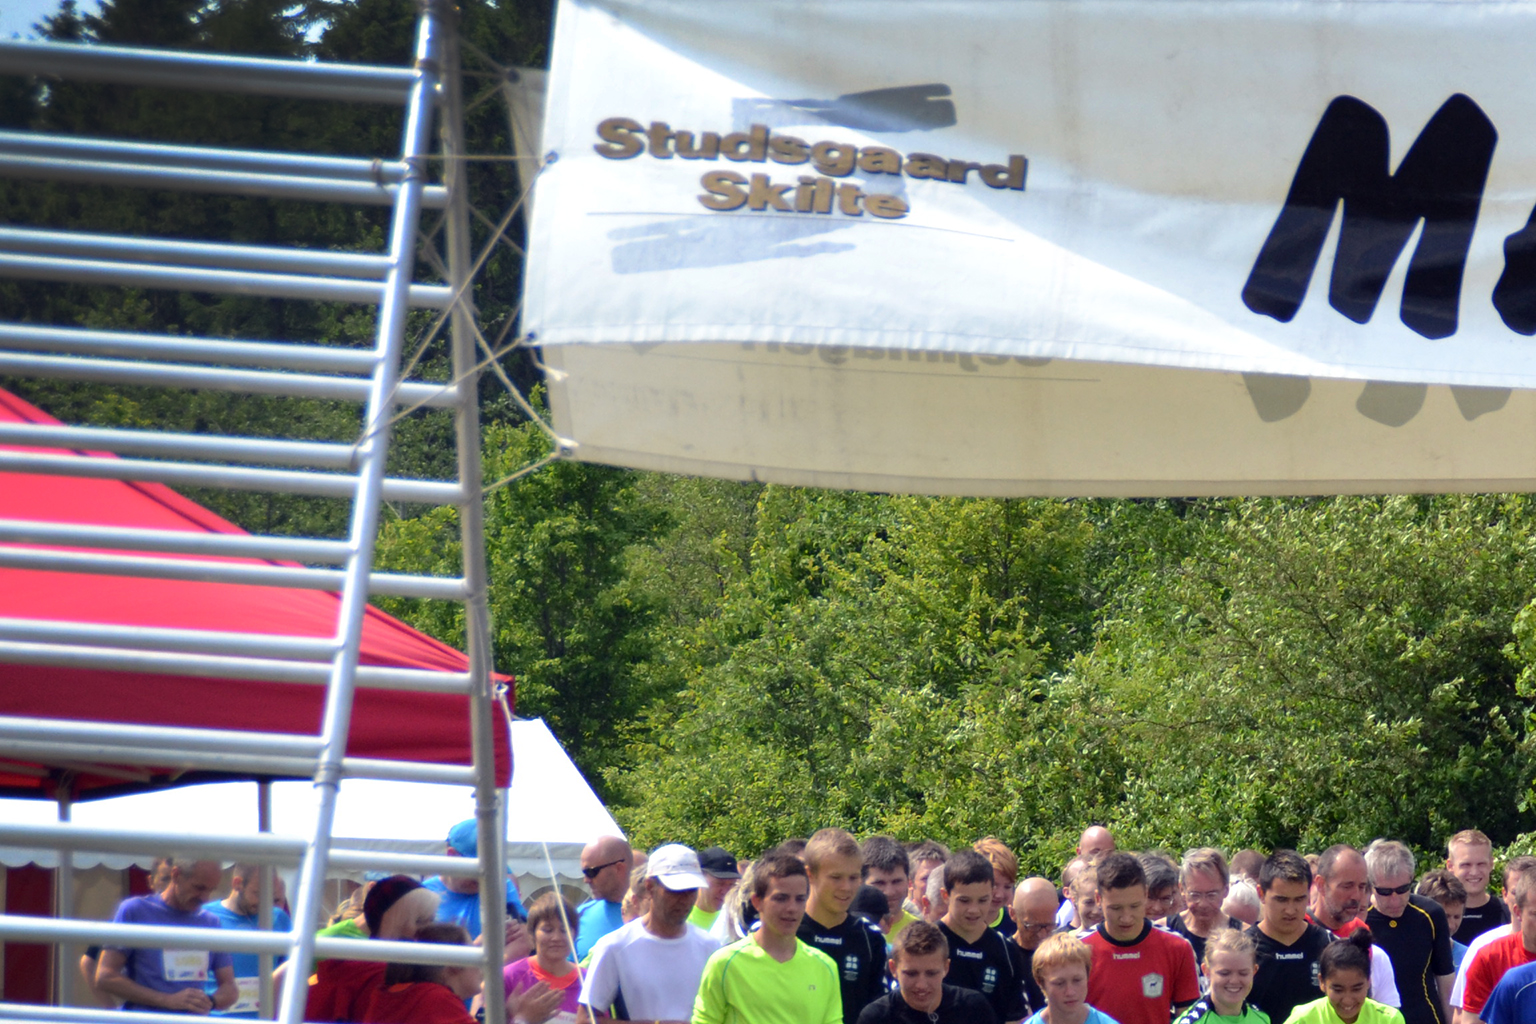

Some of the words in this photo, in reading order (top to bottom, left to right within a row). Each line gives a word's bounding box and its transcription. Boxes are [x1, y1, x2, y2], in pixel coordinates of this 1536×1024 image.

[594, 117, 1029, 192] Studsgaard
[698, 170, 910, 220] Skilte
[814, 935, 842, 945] hummel
[956, 948, 983, 959] hummel
[1113, 952, 1140, 960] hummel
[1275, 952, 1304, 960] hummel
